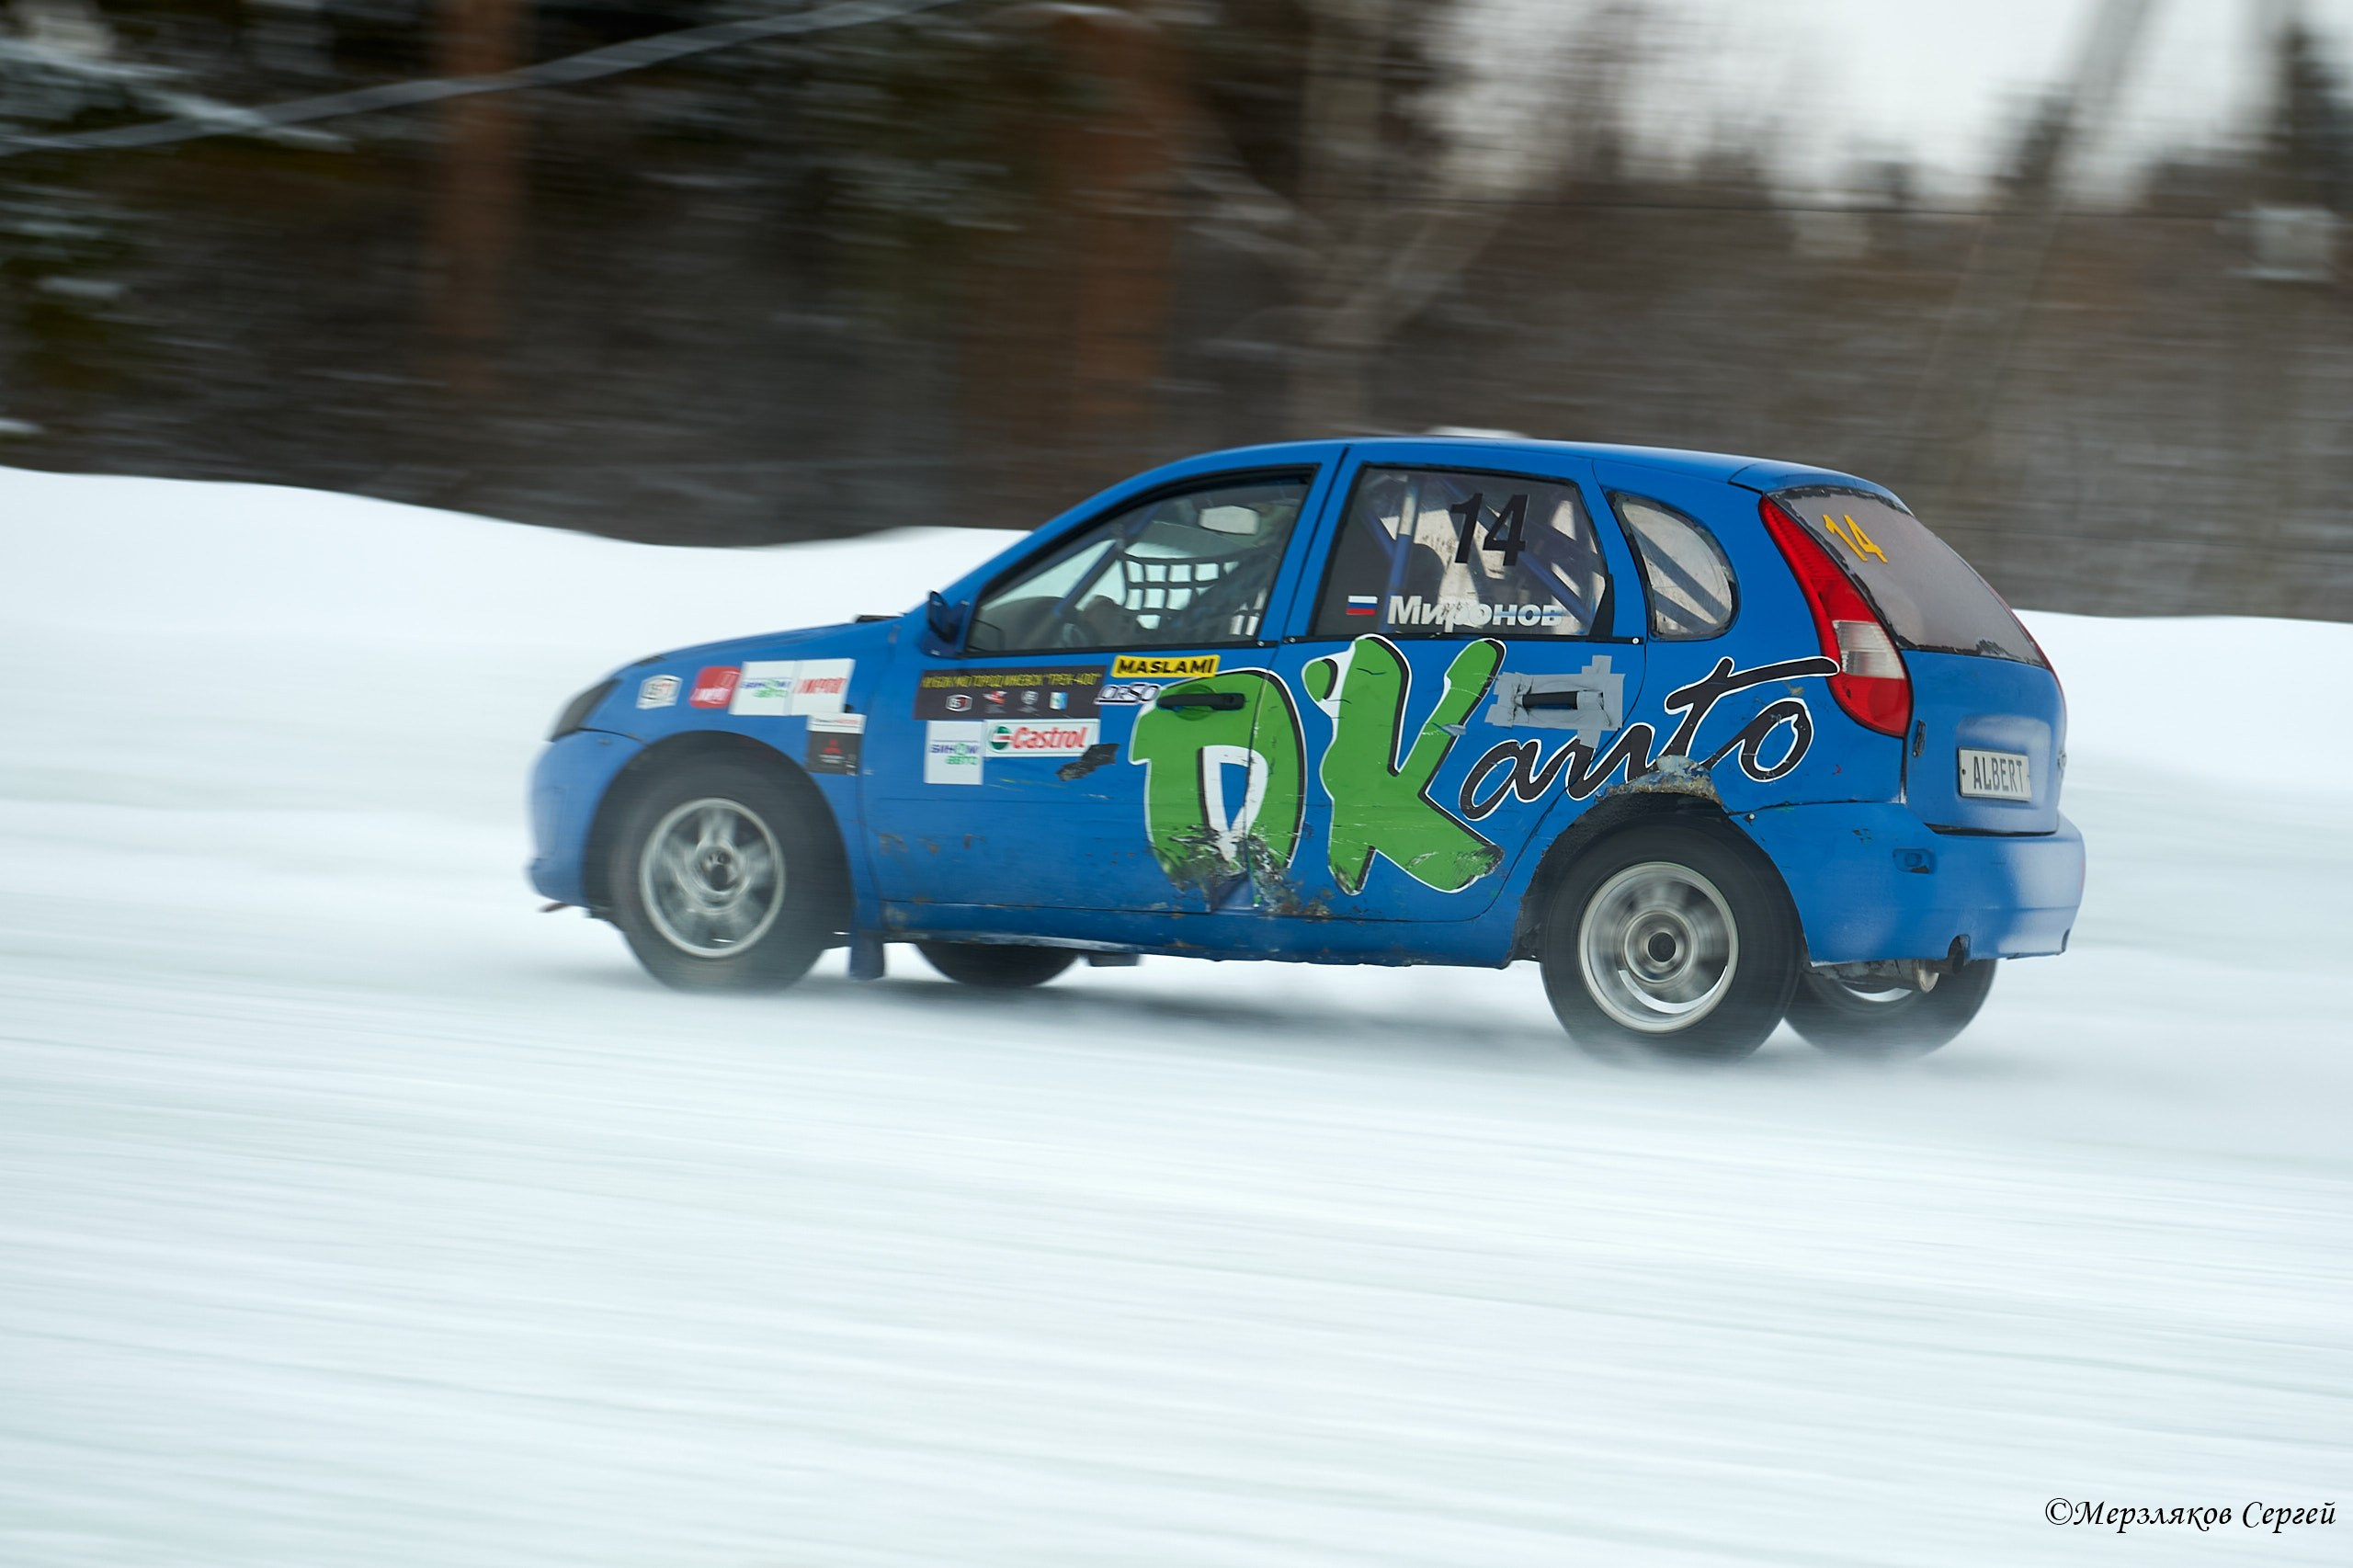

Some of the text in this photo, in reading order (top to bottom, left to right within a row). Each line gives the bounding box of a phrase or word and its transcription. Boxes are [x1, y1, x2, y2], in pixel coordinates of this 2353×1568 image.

[1451, 493, 1529, 566] 14
[1823, 515, 1888, 563] 14
[1387, 595, 1564, 632] Миронов
[1117, 658, 1215, 676] MASLAMI
[1012, 726, 1088, 749] Castrol
[1973, 755, 2023, 793] ALBERT
